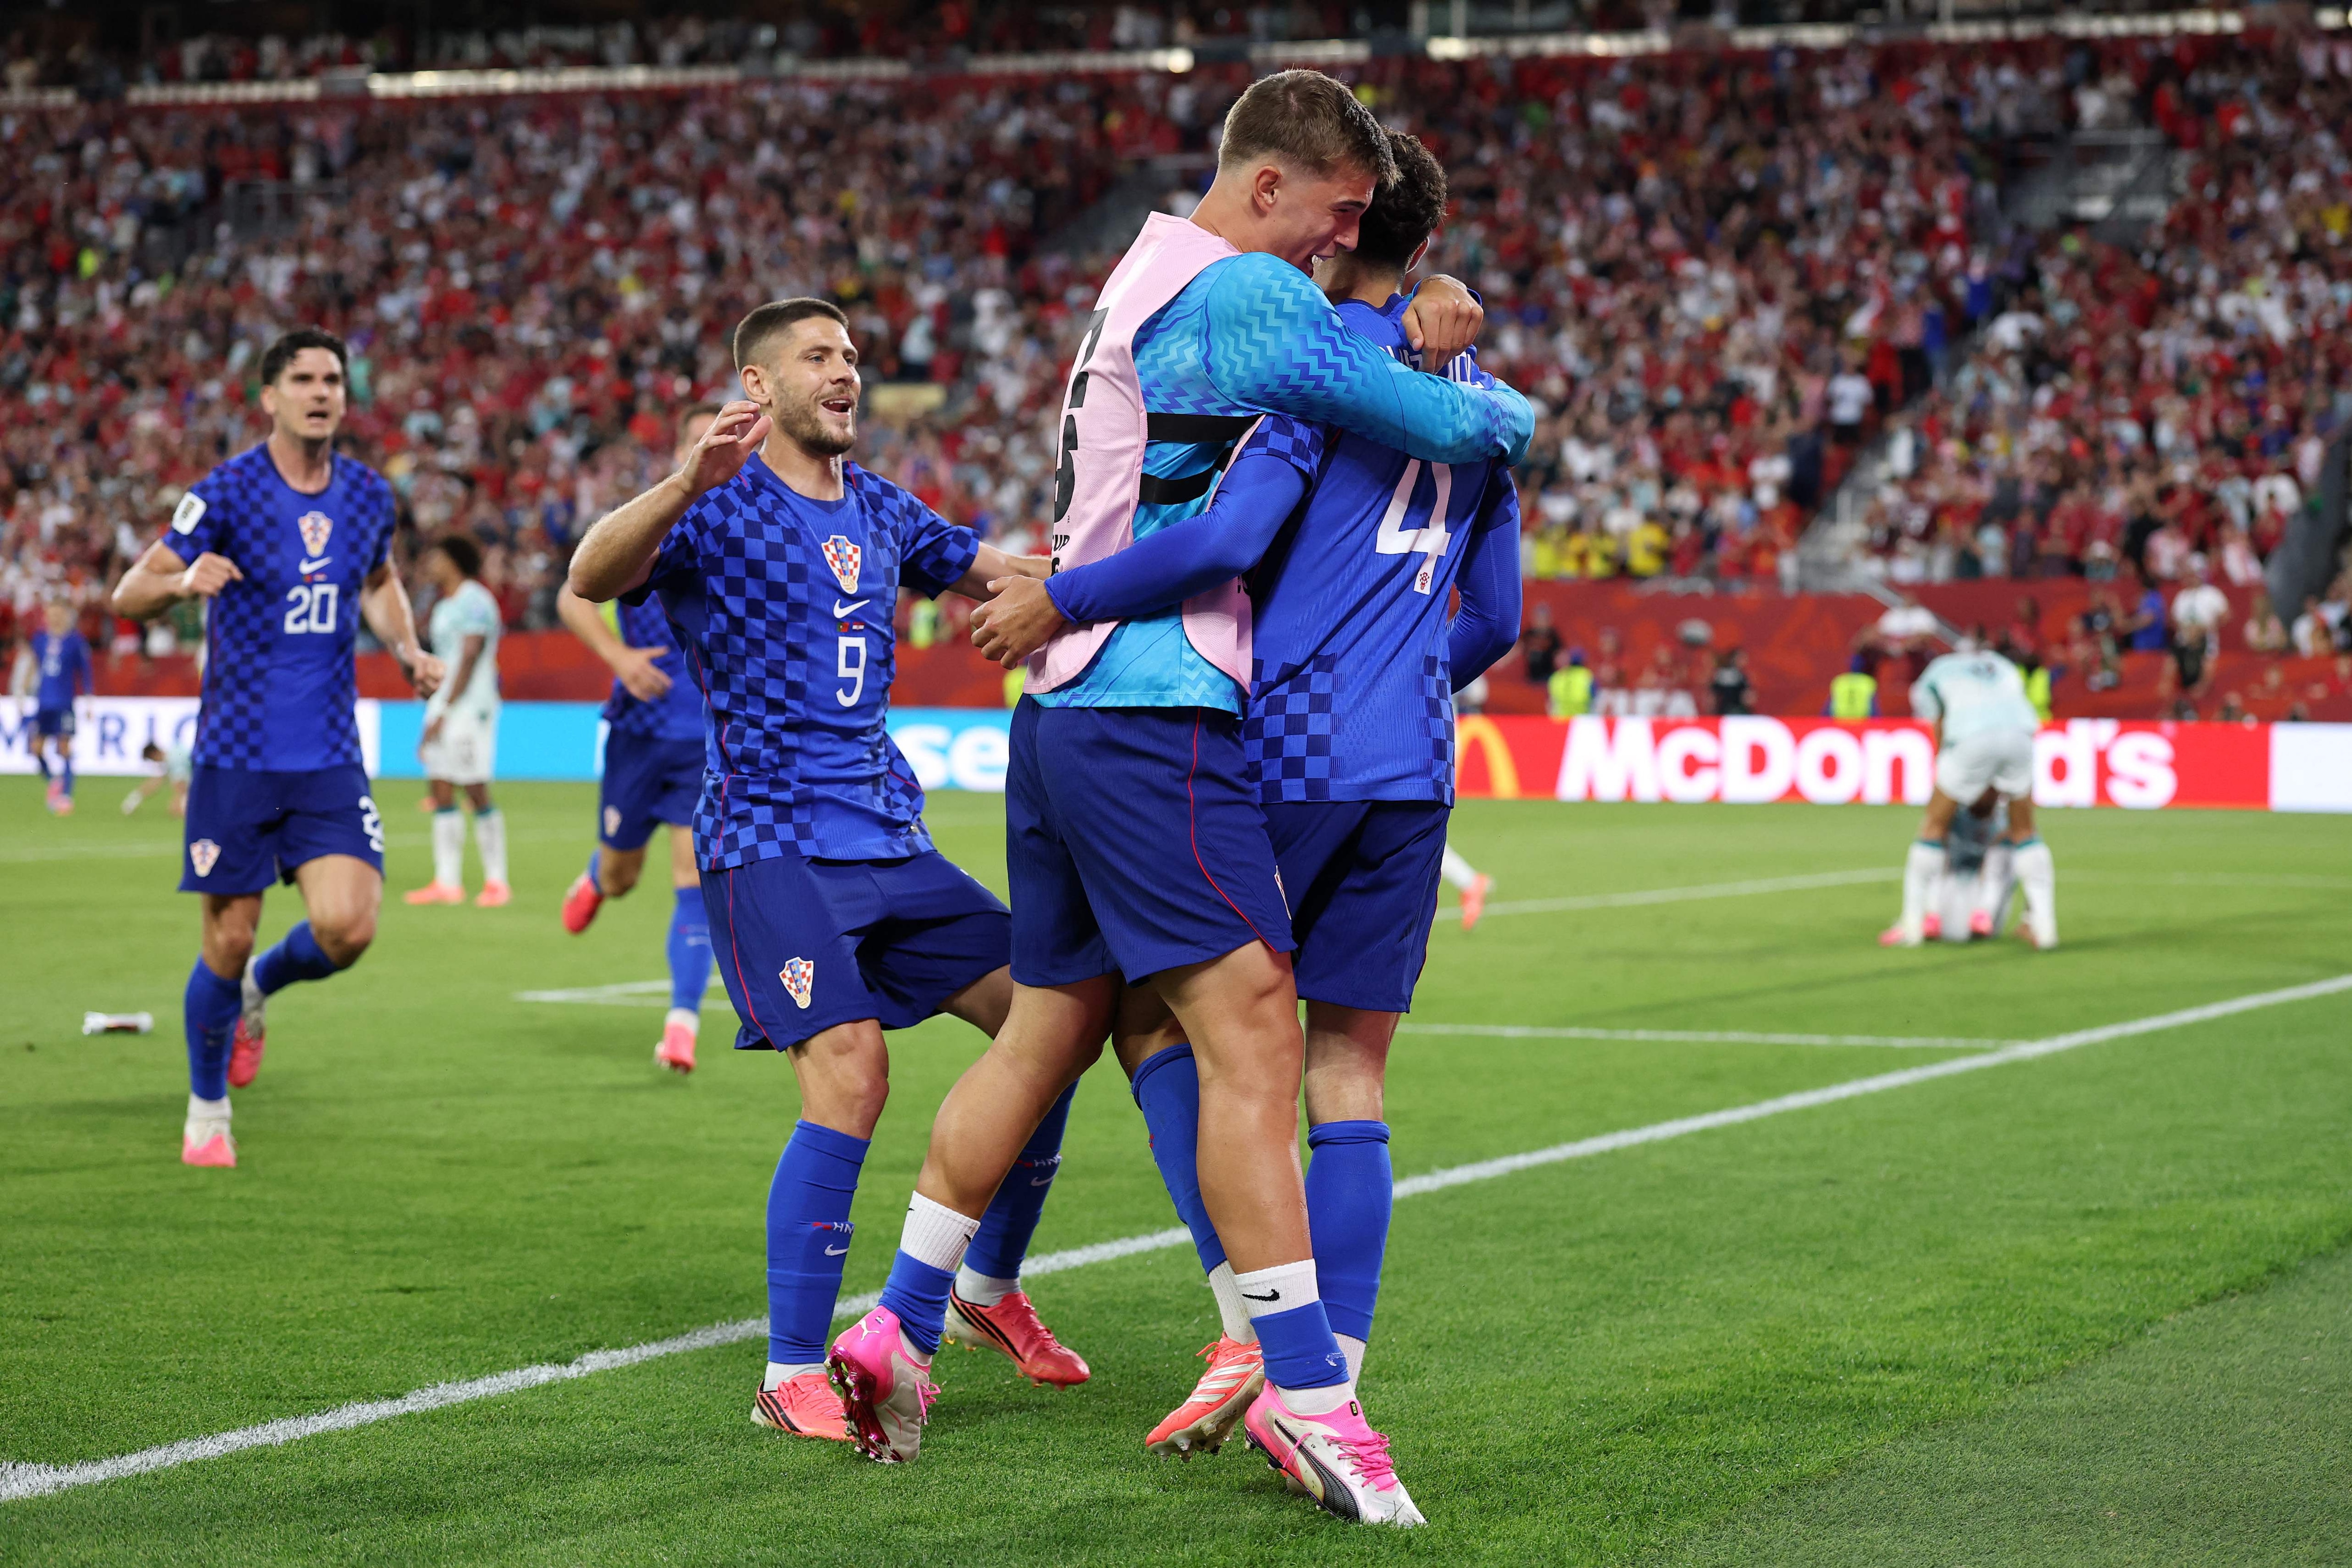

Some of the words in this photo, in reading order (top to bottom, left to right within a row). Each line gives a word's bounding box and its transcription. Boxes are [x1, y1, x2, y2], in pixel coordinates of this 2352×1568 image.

[1052, 534, 1070, 552] UP
[1375, 459, 1452, 595] 4
[284, 584, 339, 634] 20
[836, 636, 867, 707] 9
[892, 723, 1010, 792] se
[1556, 716, 2178, 809] McDond's
